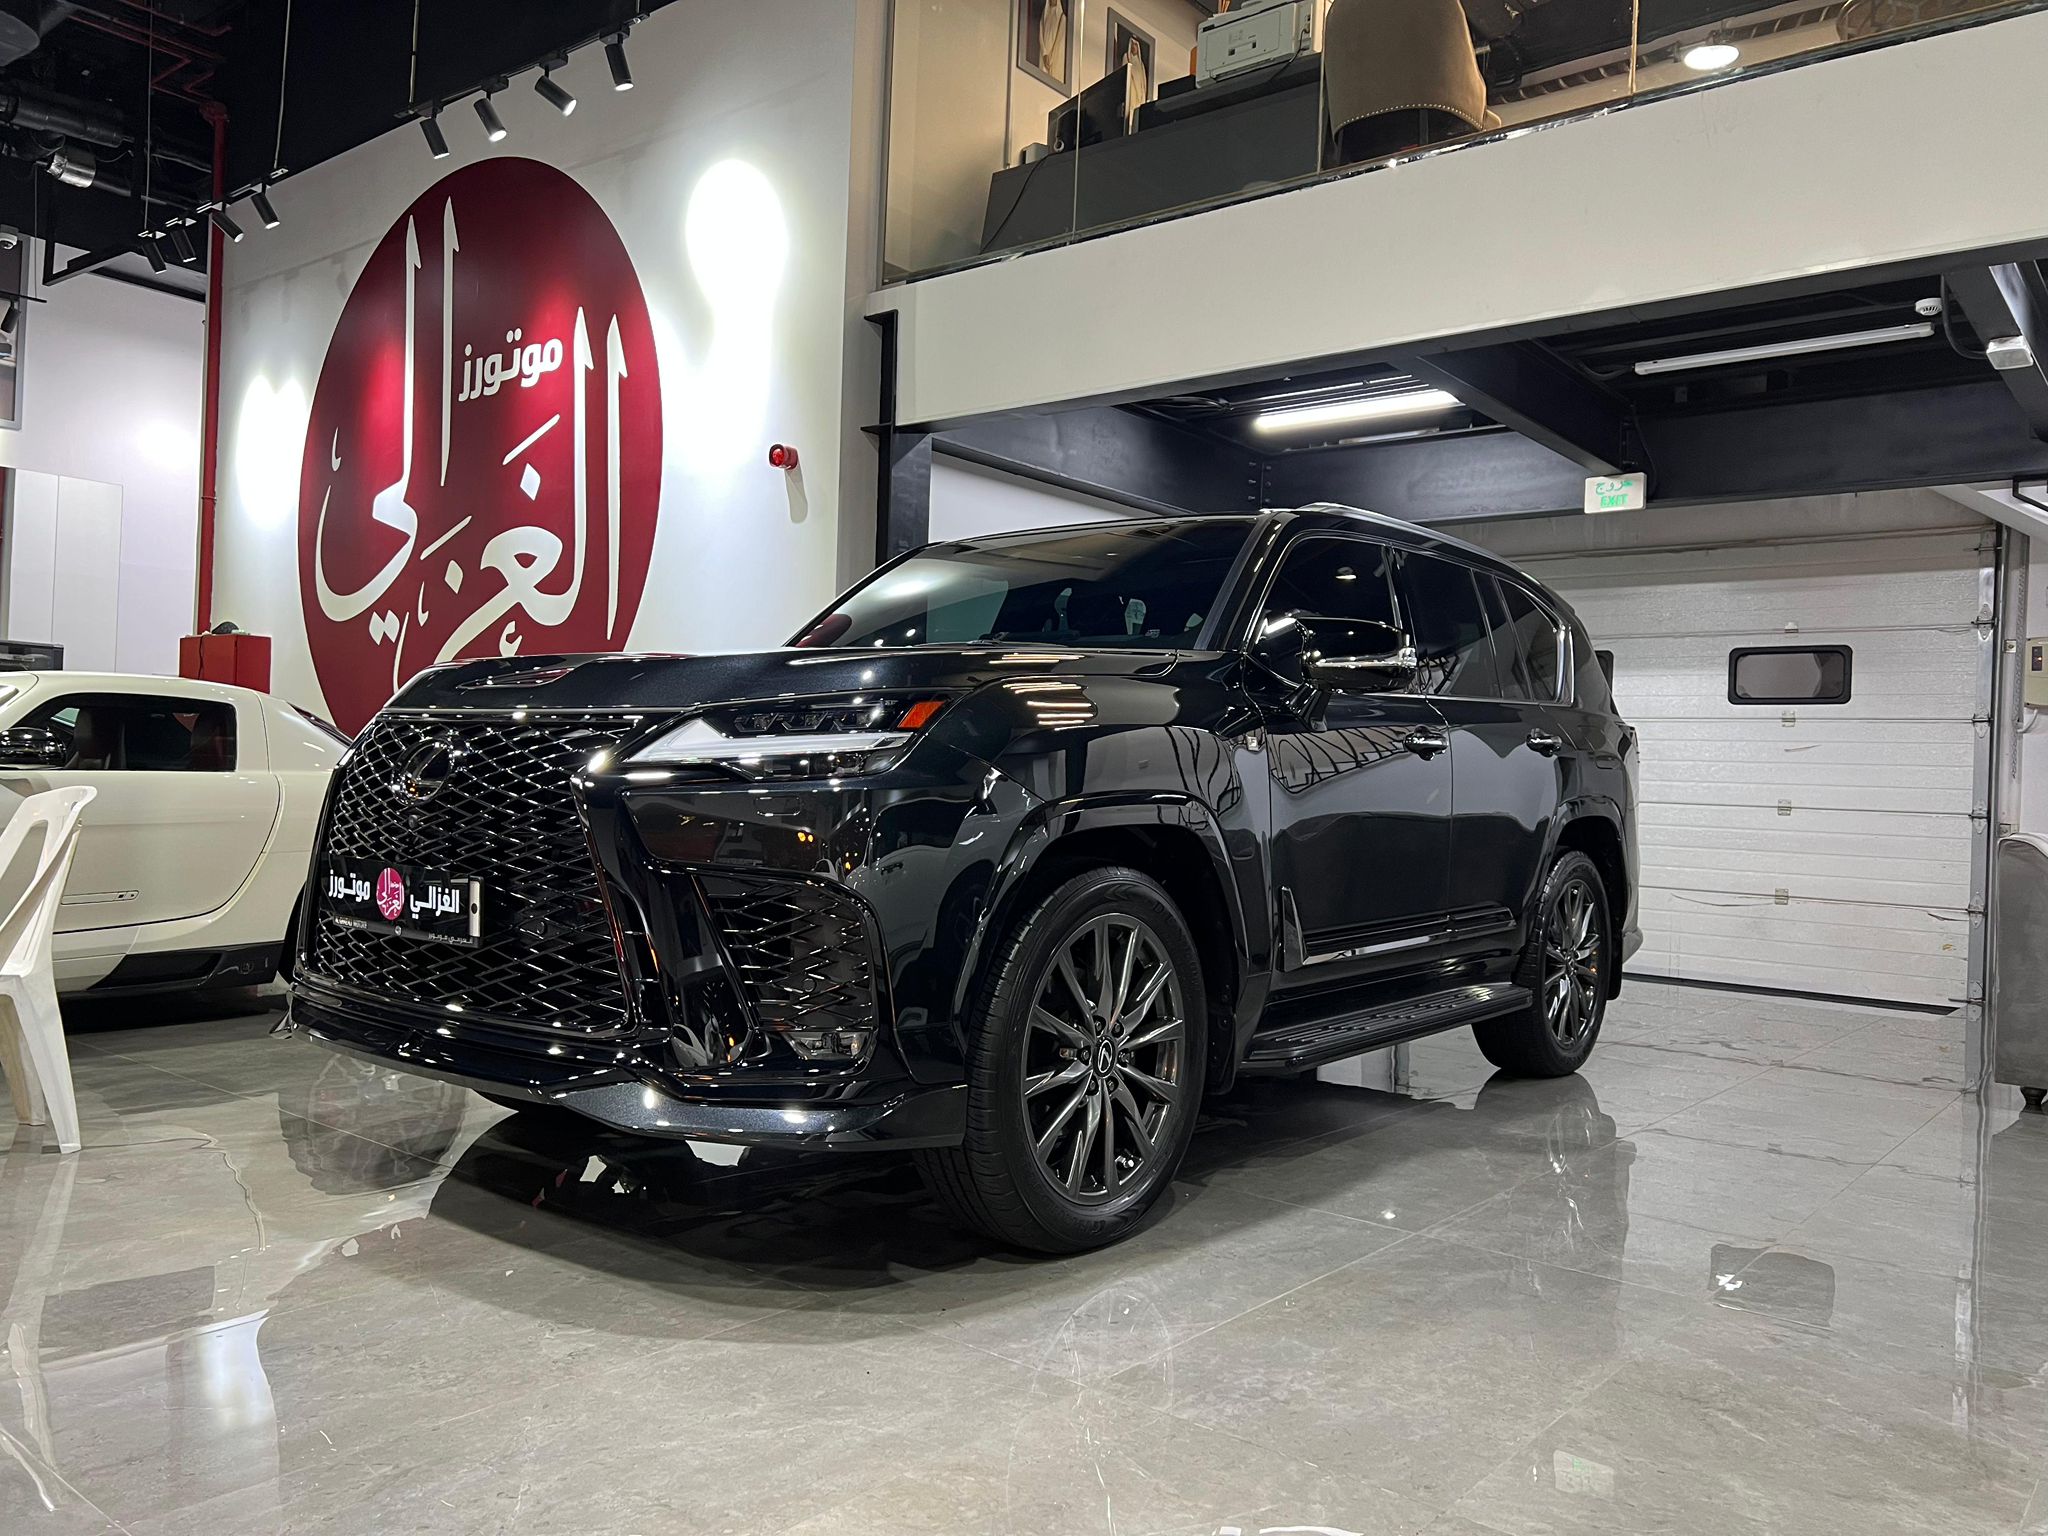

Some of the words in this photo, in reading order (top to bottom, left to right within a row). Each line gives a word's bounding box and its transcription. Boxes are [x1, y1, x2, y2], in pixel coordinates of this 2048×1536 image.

[458, 328, 563, 402] موتورز
[1595, 480, 1633, 496] خروج
[1600, 494, 1629, 508] EXIT
[328, 869, 371, 902] موتورز
[409, 885, 460, 920] الغزالي
